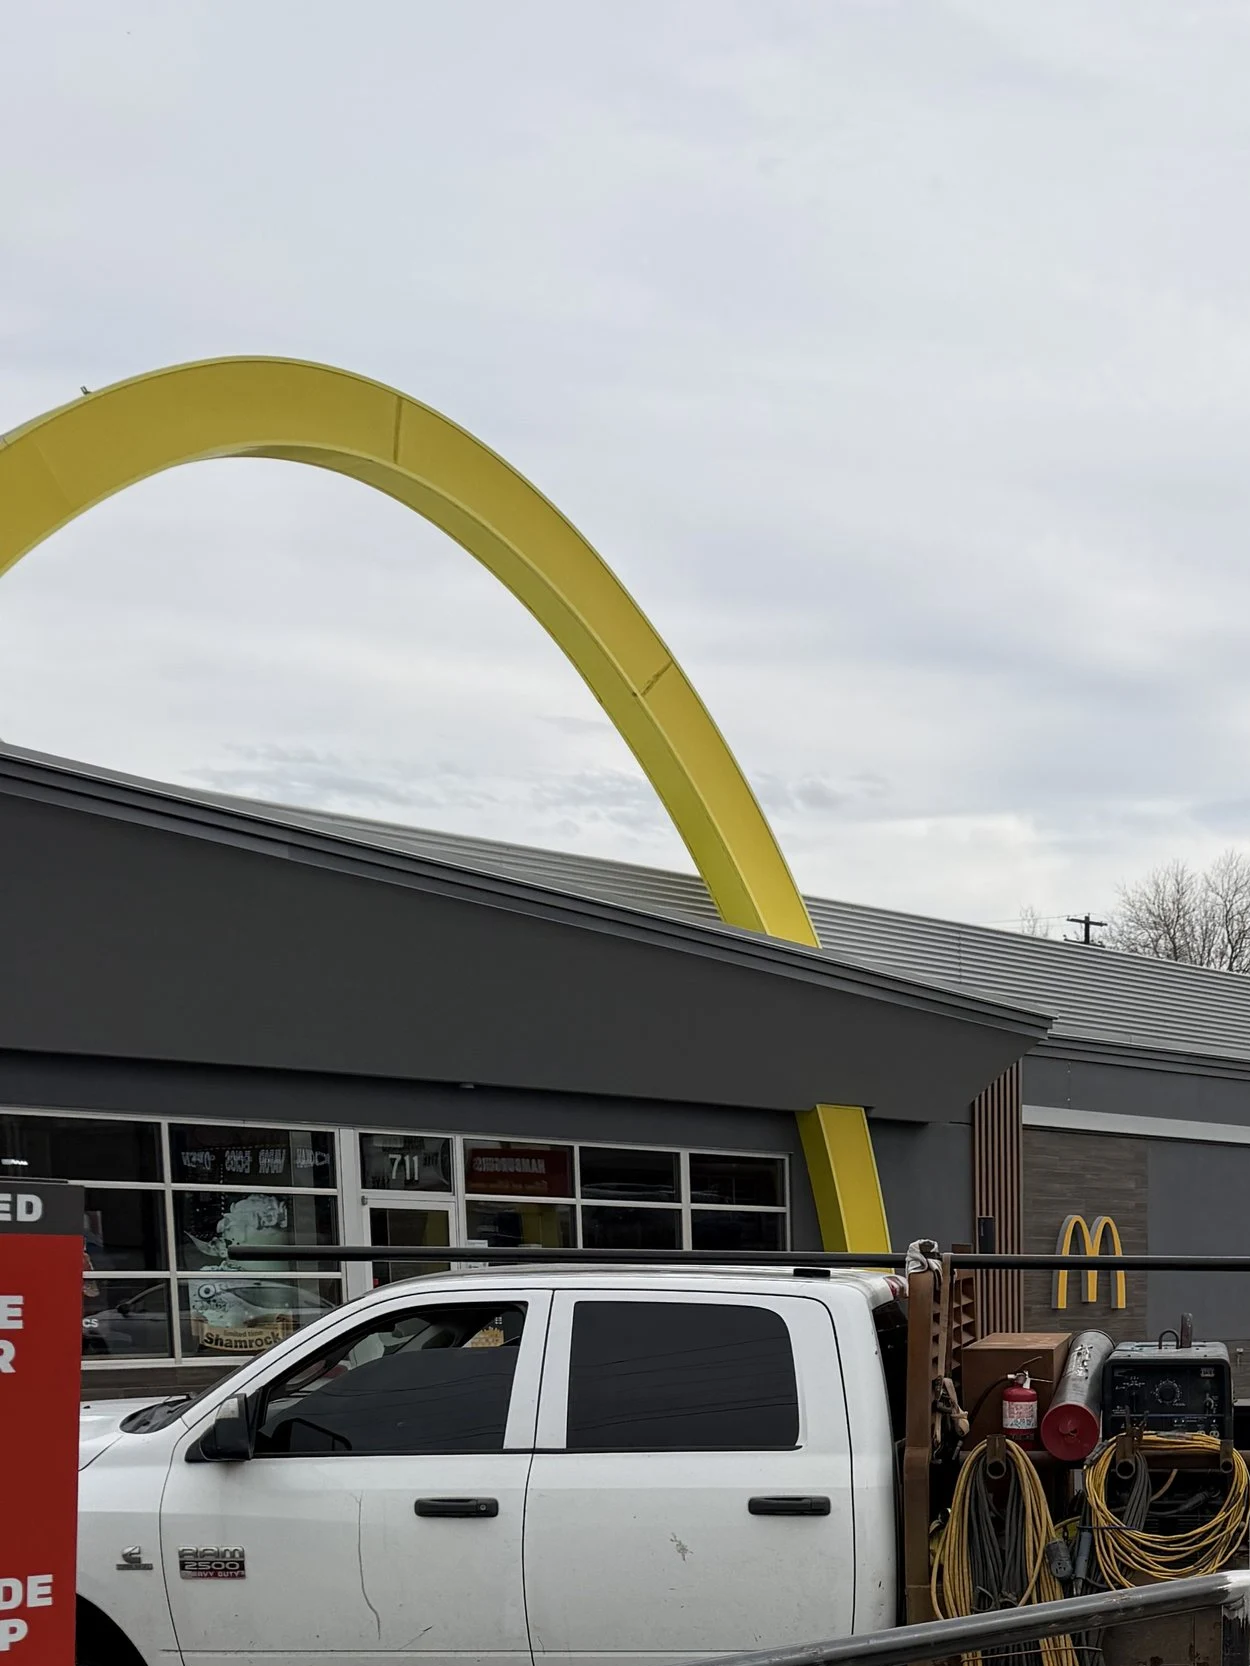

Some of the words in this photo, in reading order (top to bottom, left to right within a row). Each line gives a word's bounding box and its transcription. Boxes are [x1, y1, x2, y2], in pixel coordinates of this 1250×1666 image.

[388, 1153, 419, 1181] 711
[203, 1331, 281, 1349] Shamrock
[178, 1546, 245, 1559] RAM
[184, 1561, 240, 1570] 2500
